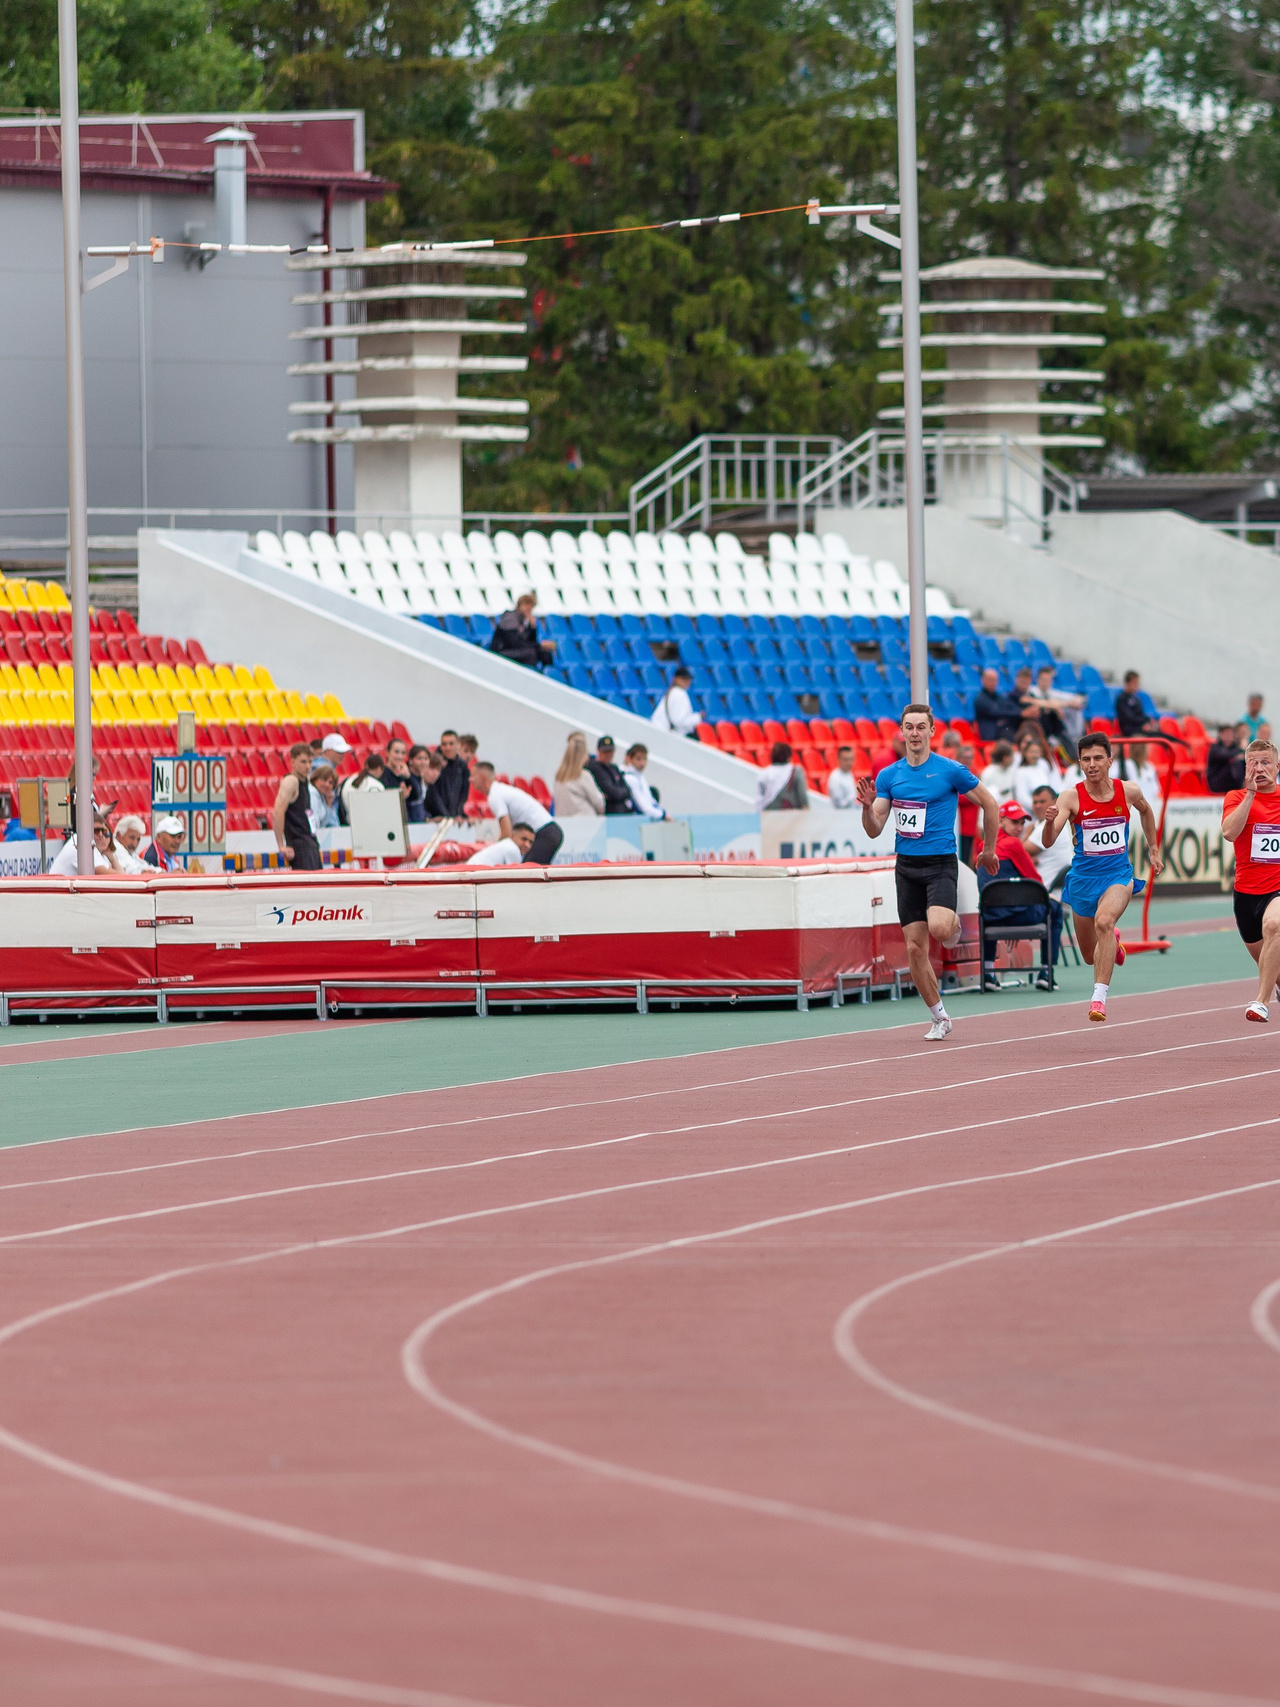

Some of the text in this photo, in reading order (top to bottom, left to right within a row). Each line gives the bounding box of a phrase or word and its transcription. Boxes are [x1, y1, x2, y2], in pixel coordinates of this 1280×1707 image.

[898, 812, 917, 827] 194
[1090, 831, 1119, 845] 400
[291, 904, 364, 926] polanik
